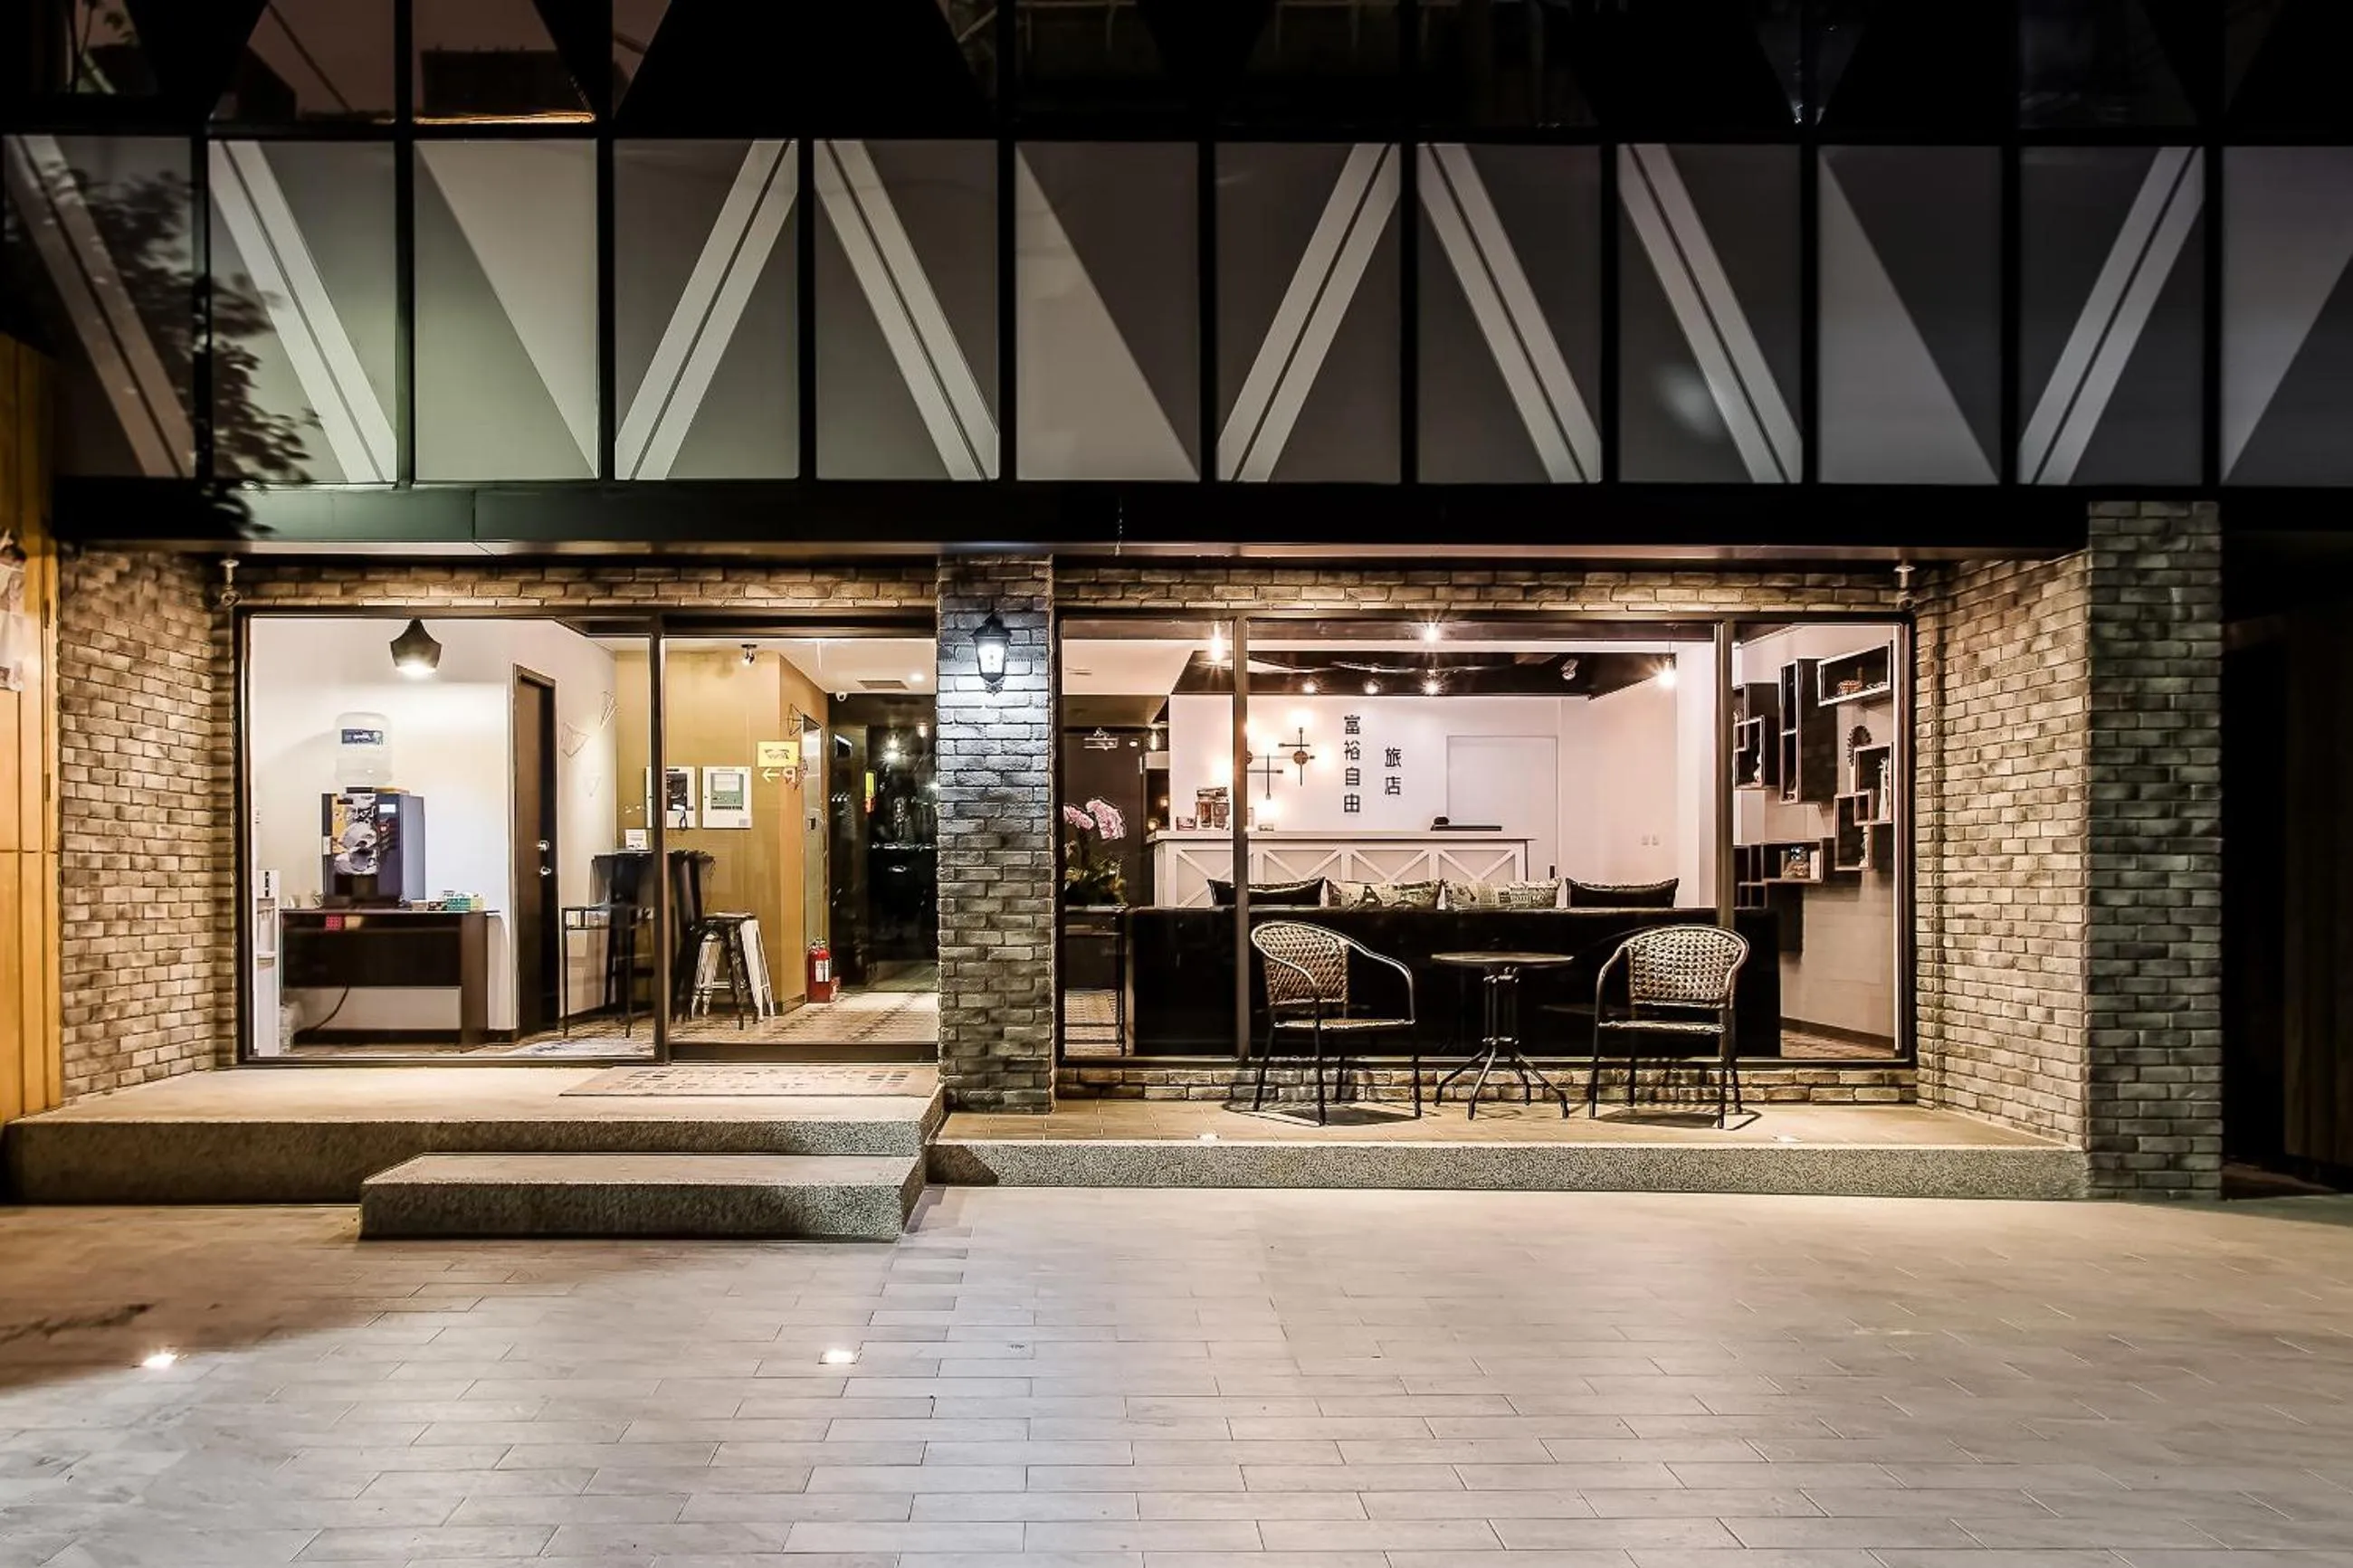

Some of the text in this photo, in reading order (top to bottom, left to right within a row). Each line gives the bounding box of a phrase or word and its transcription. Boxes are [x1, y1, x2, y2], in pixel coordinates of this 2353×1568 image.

[1344, 715, 1361, 813] 富裕自由
[1385, 747, 1402, 796] 旅店
